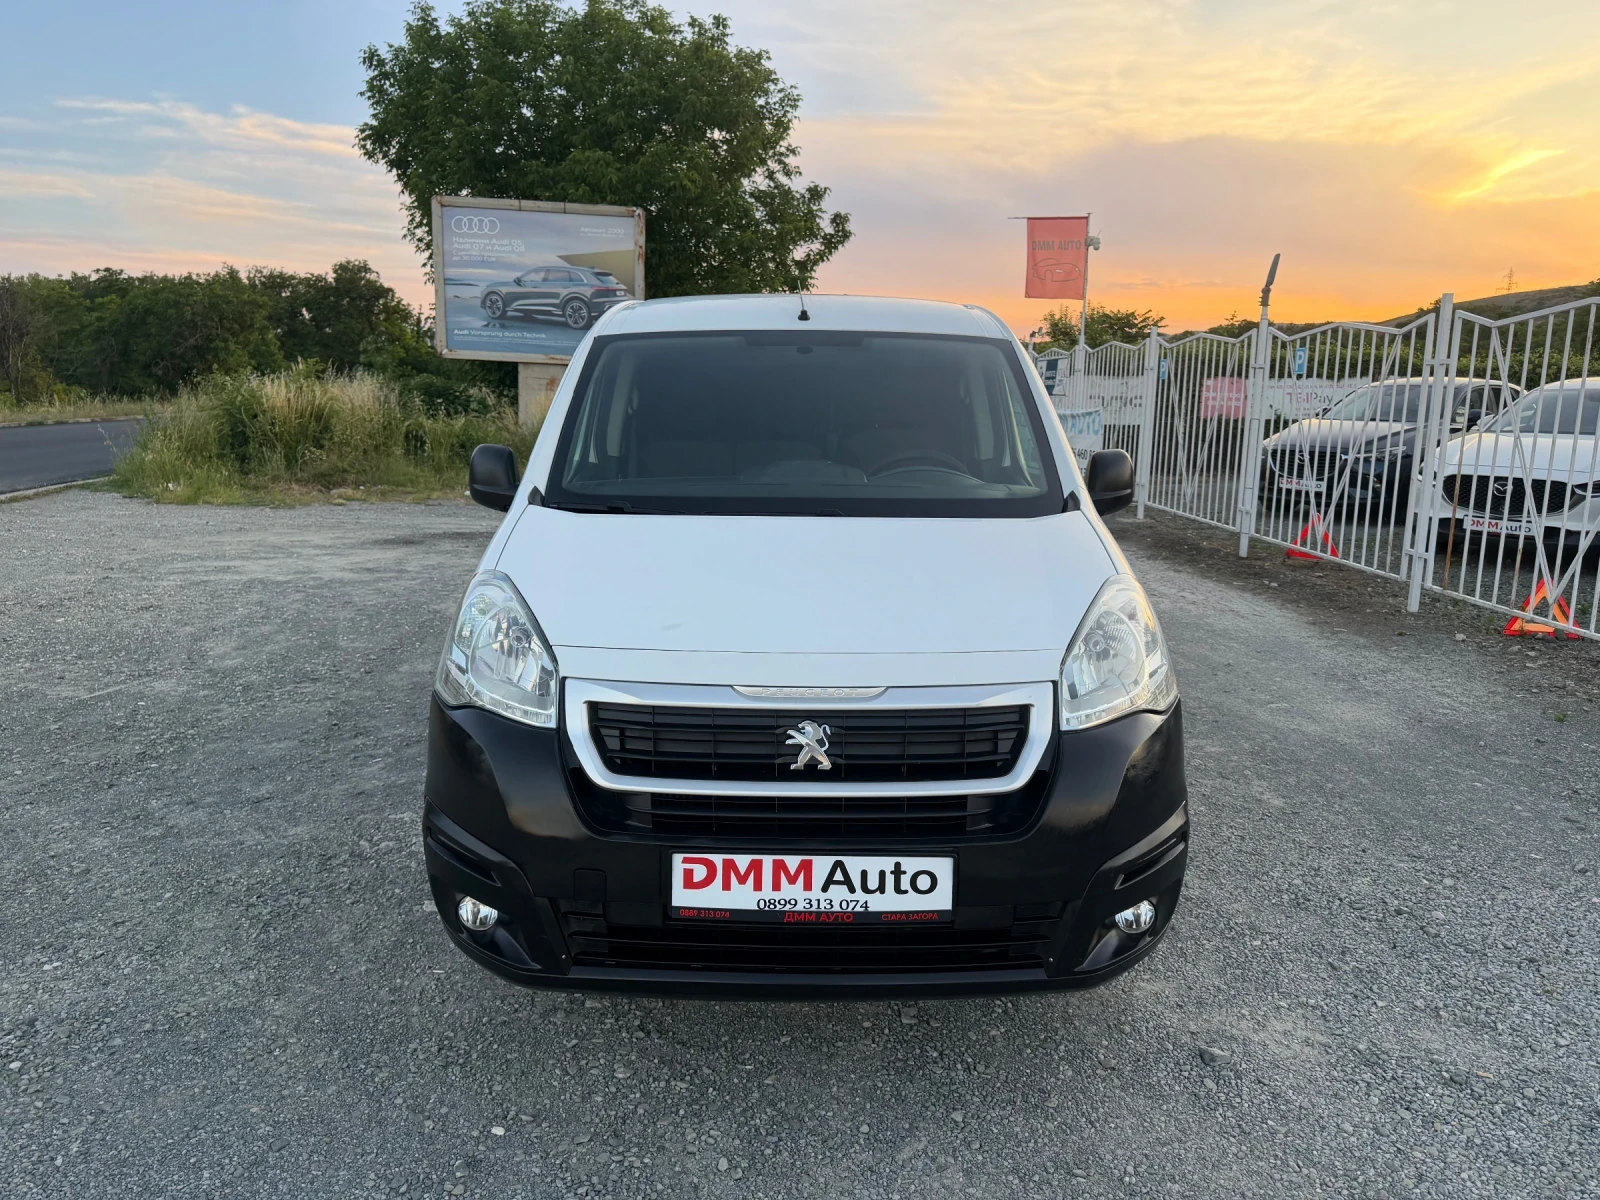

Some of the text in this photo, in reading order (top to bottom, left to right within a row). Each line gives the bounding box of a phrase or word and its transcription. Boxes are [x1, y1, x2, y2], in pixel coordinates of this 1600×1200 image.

[473, 243, 484, 251] Q7
[1031, 240, 1081, 250] DMM AUTO
[470, 330, 502, 338] Vorsprung
[1296, 350, 1305, 371] P
[761, 688, 858, 697] PEUGEOT
[681, 857, 939, 895] DMM Auto
[756, 898, 870, 911] 0899 313 074
[700, 910, 714, 918] 313
[784, 912, 854, 923] ДММ АУТО
[881, 912, 939, 921] СТАРА ЗАГОРА
